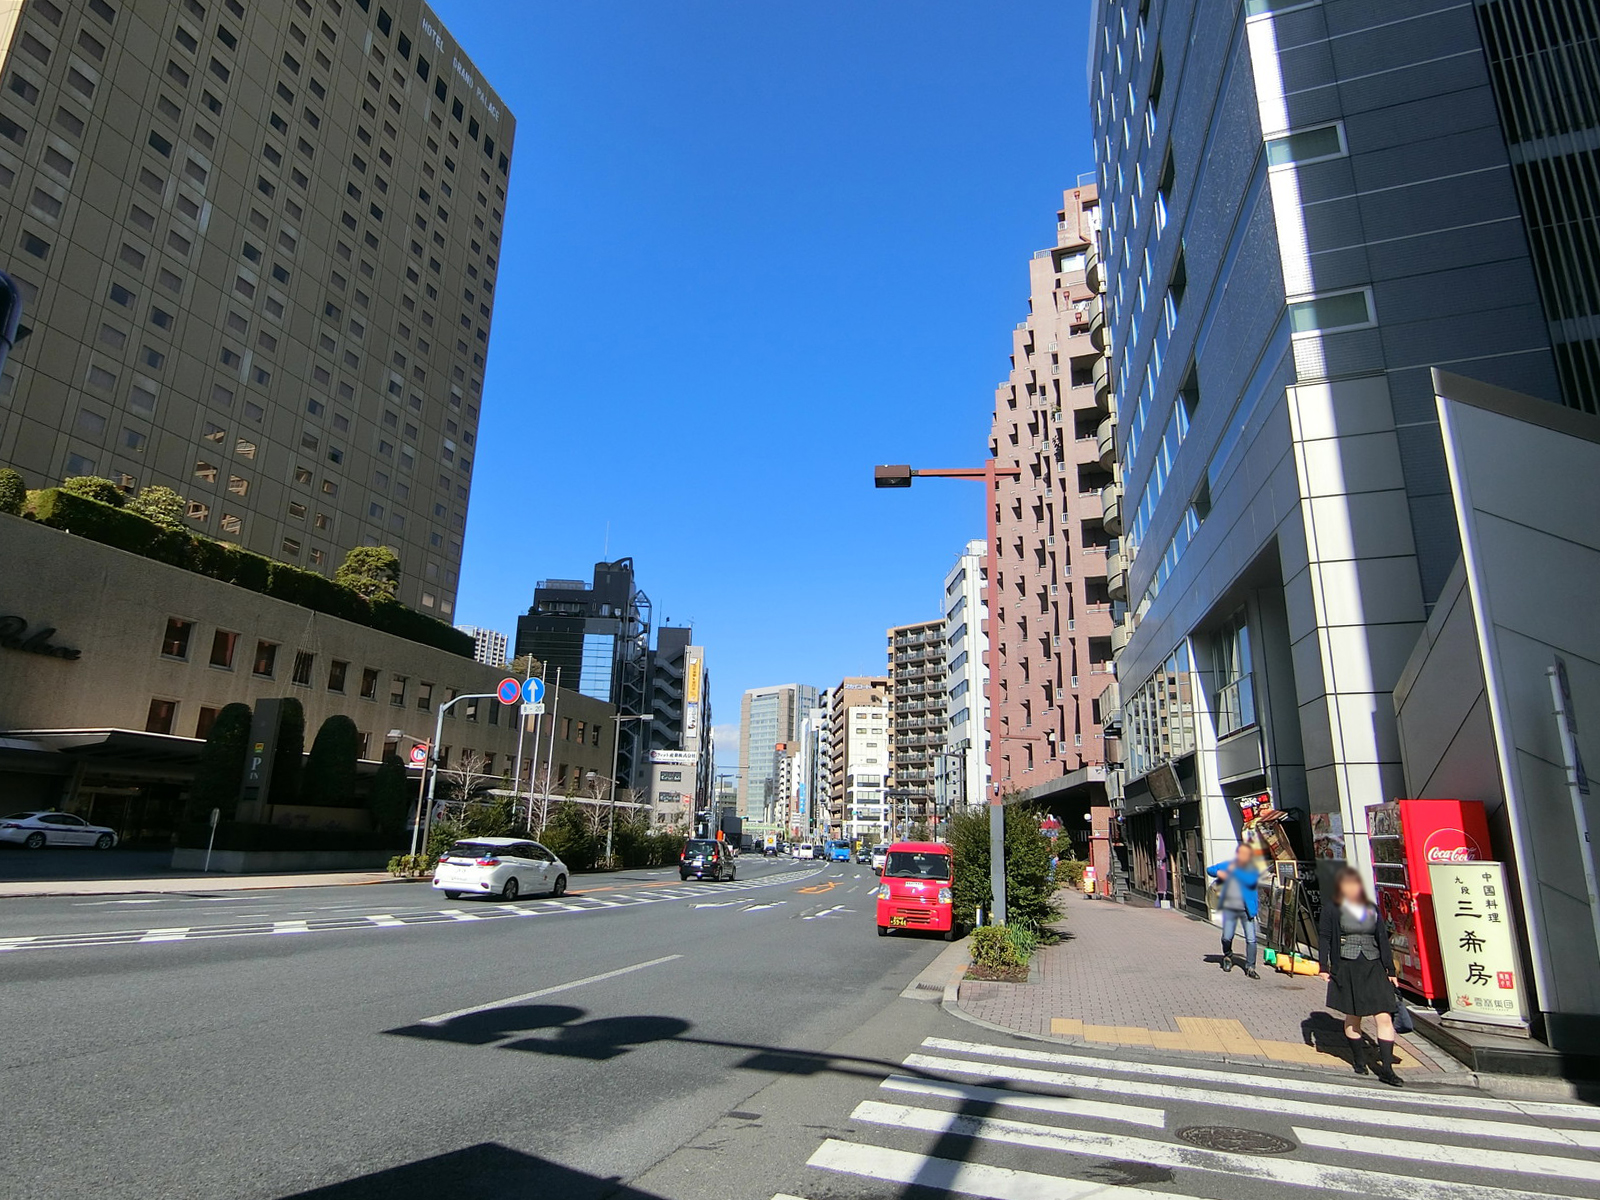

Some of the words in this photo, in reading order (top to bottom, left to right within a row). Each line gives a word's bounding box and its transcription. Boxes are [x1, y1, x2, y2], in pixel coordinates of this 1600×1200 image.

[422, 18, 445, 54] HOTEL
[452, 57, 474, 89] GRAND
[476, 86, 500, 123] PALACE
[251, 757, 262, 770] P
[1427, 846, 1477, 861] Coca-Cola
[1454, 876, 1470, 895] 九段
[1481, 872, 1501, 923] 中国料理
[1454, 900, 1493, 986] 三希房
